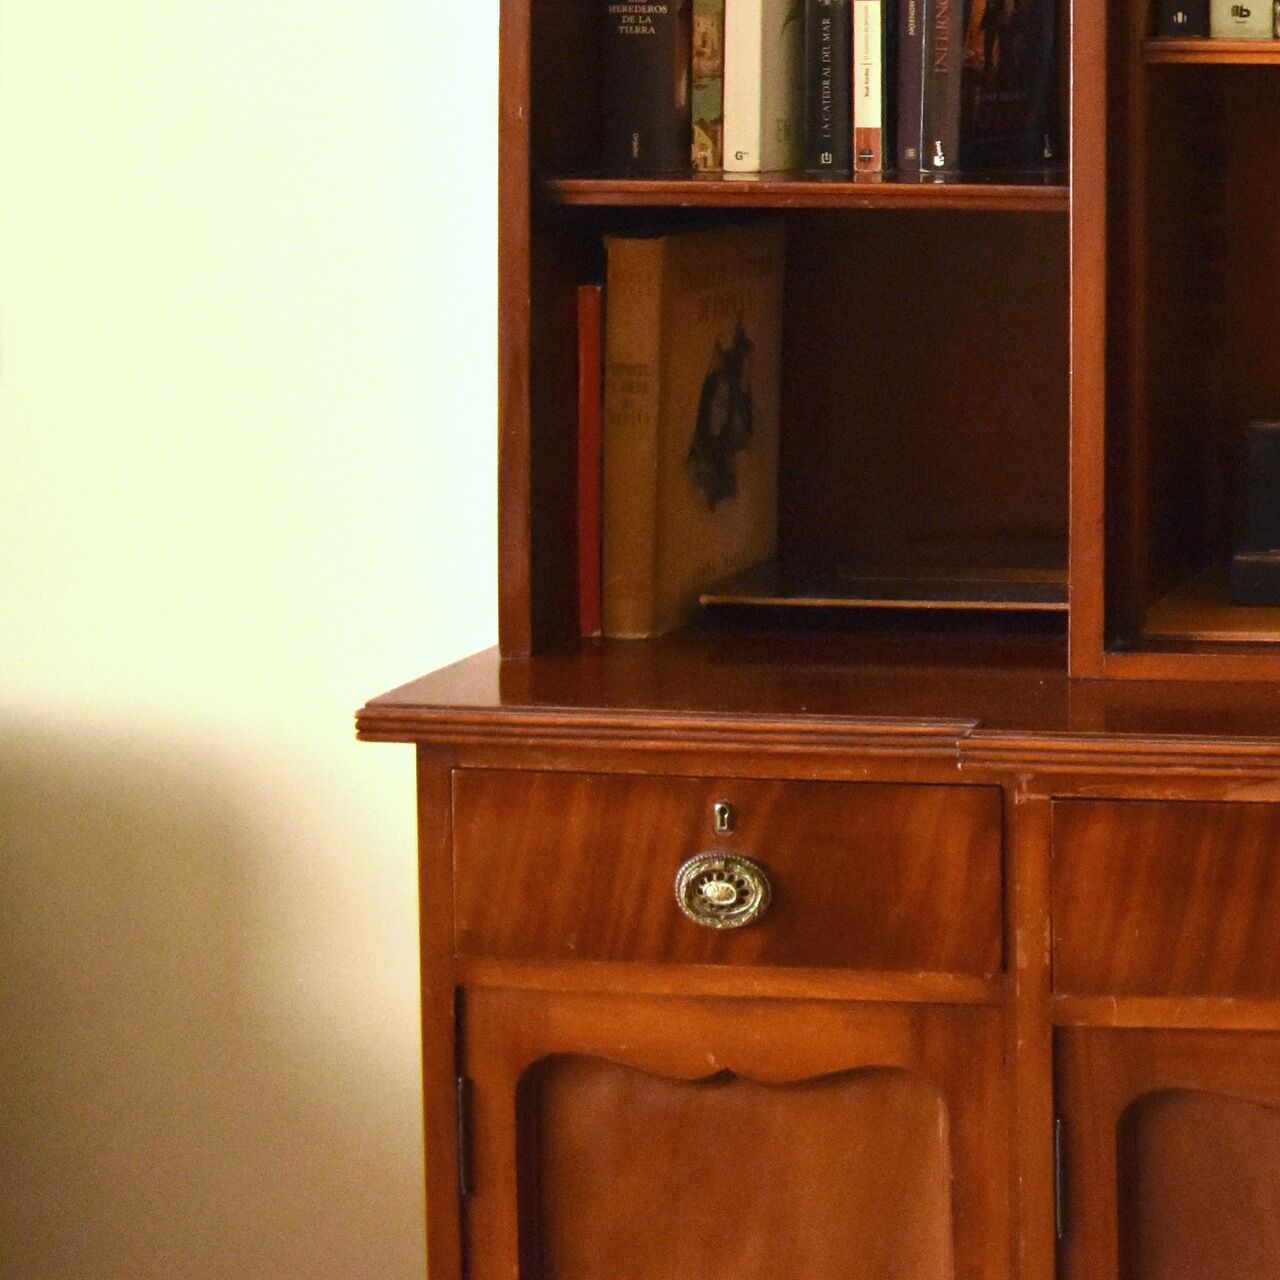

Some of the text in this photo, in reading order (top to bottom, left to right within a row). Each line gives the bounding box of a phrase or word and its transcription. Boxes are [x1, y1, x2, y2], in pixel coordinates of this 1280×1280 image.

[622, 15, 653, 23] DE LA
[822, 17, 832, 138] LA CATEDRAL DEL MAR
